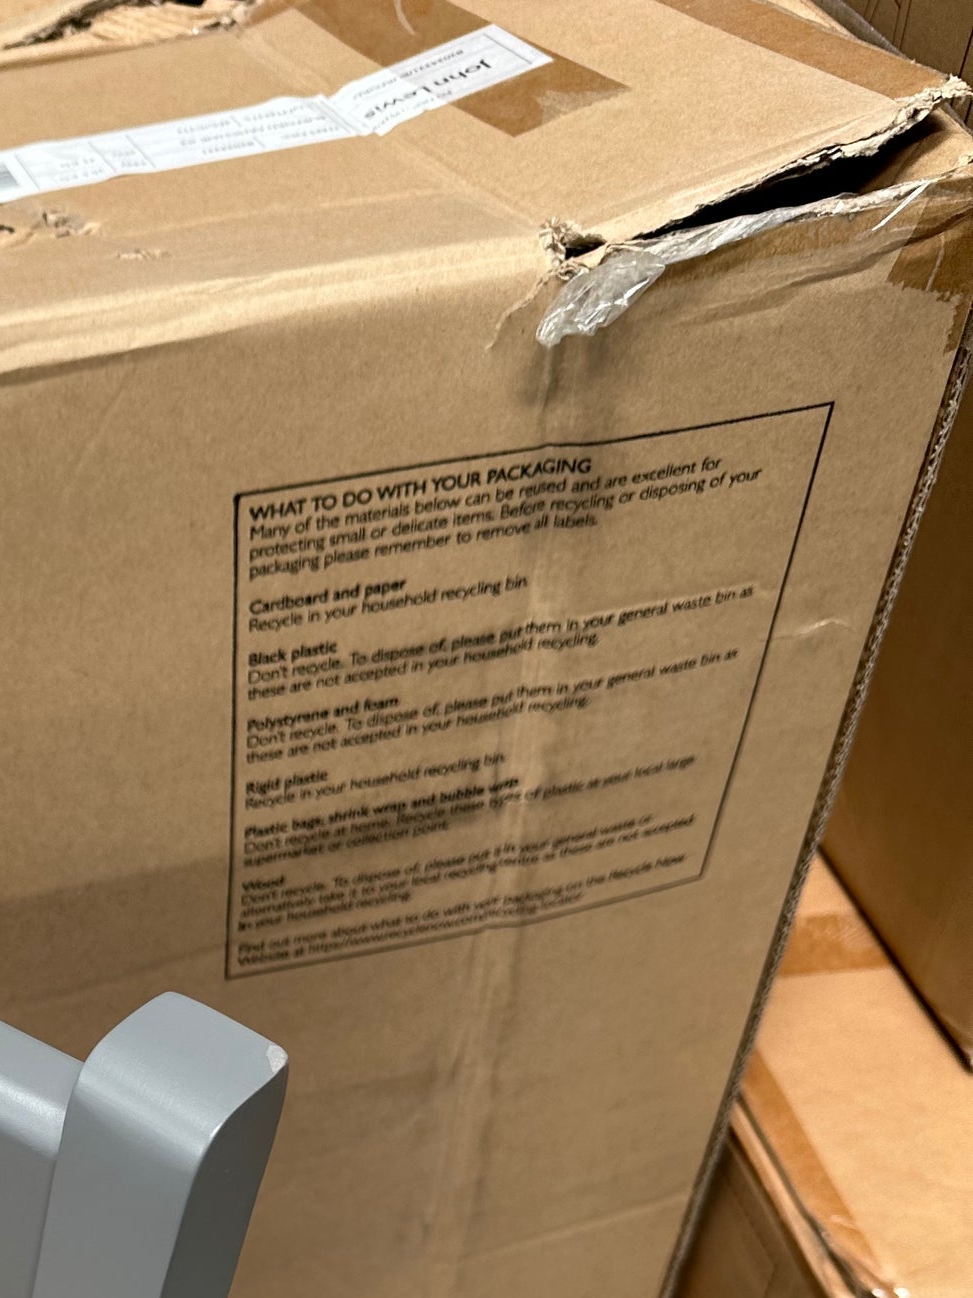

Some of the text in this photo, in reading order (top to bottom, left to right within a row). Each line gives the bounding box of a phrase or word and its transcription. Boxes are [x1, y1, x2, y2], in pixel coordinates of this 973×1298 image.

[433, 58, 492, 87] John
[249, 457, 591, 521] WHAT TO DO WITH YOUR PACKAGING
[249, 456, 721, 540] Many of the materials below can be reused and are excellent for
[249, 536, 324, 562] protecting
[329, 526, 365, 546] small
[370, 525, 387, 540] or
[391, 516, 448, 536] delicate
[500, 500, 544, 519] Before
[547, 493, 614, 519] recycling
[618, 490, 635, 504] or
[639, 478, 705, 500] disposing
[709, 471, 726, 488] of
[727, 468, 762, 488] your
[249, 555, 319, 581] packaging
[323, 547, 369, 569] please
[374, 534, 450, 556] remember
[456, 531, 471, 544] to
[476, 522, 530, 540] remove
[534, 514, 548, 529] all
[248, 612, 302, 632] Recycle
[307, 609, 320, 622] in
[325, 604, 357, 622] your
[361, 588, 437, 613] household
[440, 580, 500, 600] recycling
[249, 579, 405, 615] Cardboard and paper
[350, 650, 368, 666] To
[371, 644, 425, 663] dispose
[451, 632, 494, 651] please
[499, 625, 523, 643] put
[524, 620, 561, 634] them
[566, 618, 578, 632] in
[582, 613, 614, 631] your
[617, 601, 668, 626] general
[672, 595, 711, 612] waste
[714, 590, 735, 604] bin
[247, 684, 285, 700] these
[289, 679, 311, 693] are
[316, 674, 339, 688] not
[344, 661, 407, 683] accepted
[411, 661, 423, 672] in
[427, 655, 458, 673] your
[463, 636, 533, 662] household
[248, 641, 336, 667] Black plastic
[247, 697, 398, 731] Polystyrene and foam
